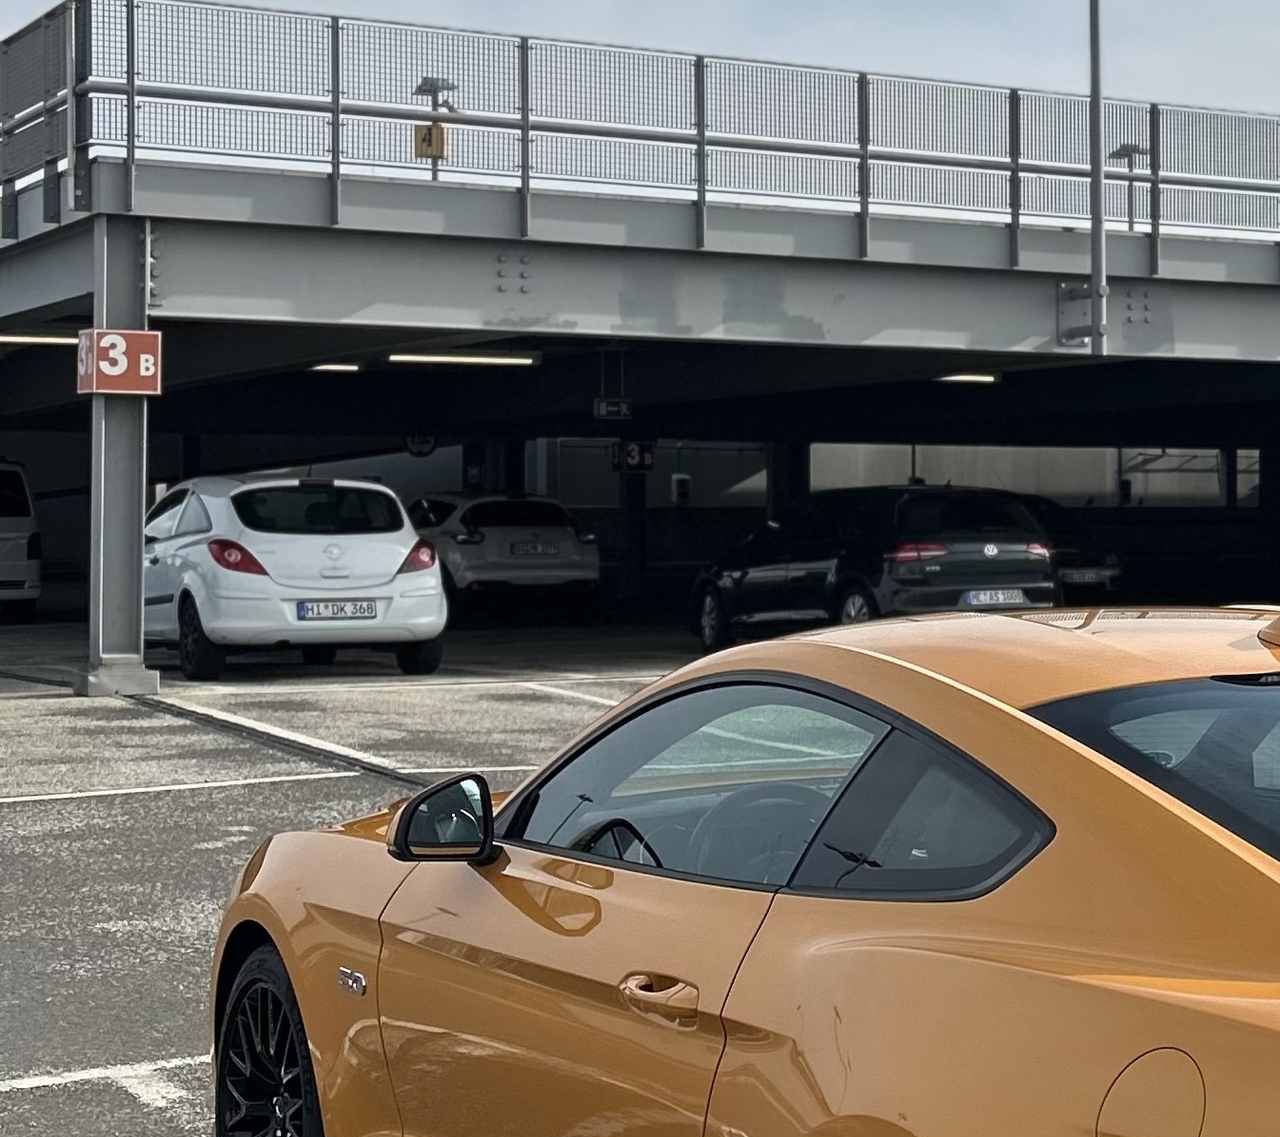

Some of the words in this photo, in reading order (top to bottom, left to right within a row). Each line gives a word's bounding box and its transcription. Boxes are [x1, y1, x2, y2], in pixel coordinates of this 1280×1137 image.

[98, 334, 128, 376] 3
[140, 353, 156, 376] B
[627, 443, 641, 466] 3
[305, 603, 322, 616] HI
[331, 603, 348, 616] DK
[350, 603, 374, 615] 368
